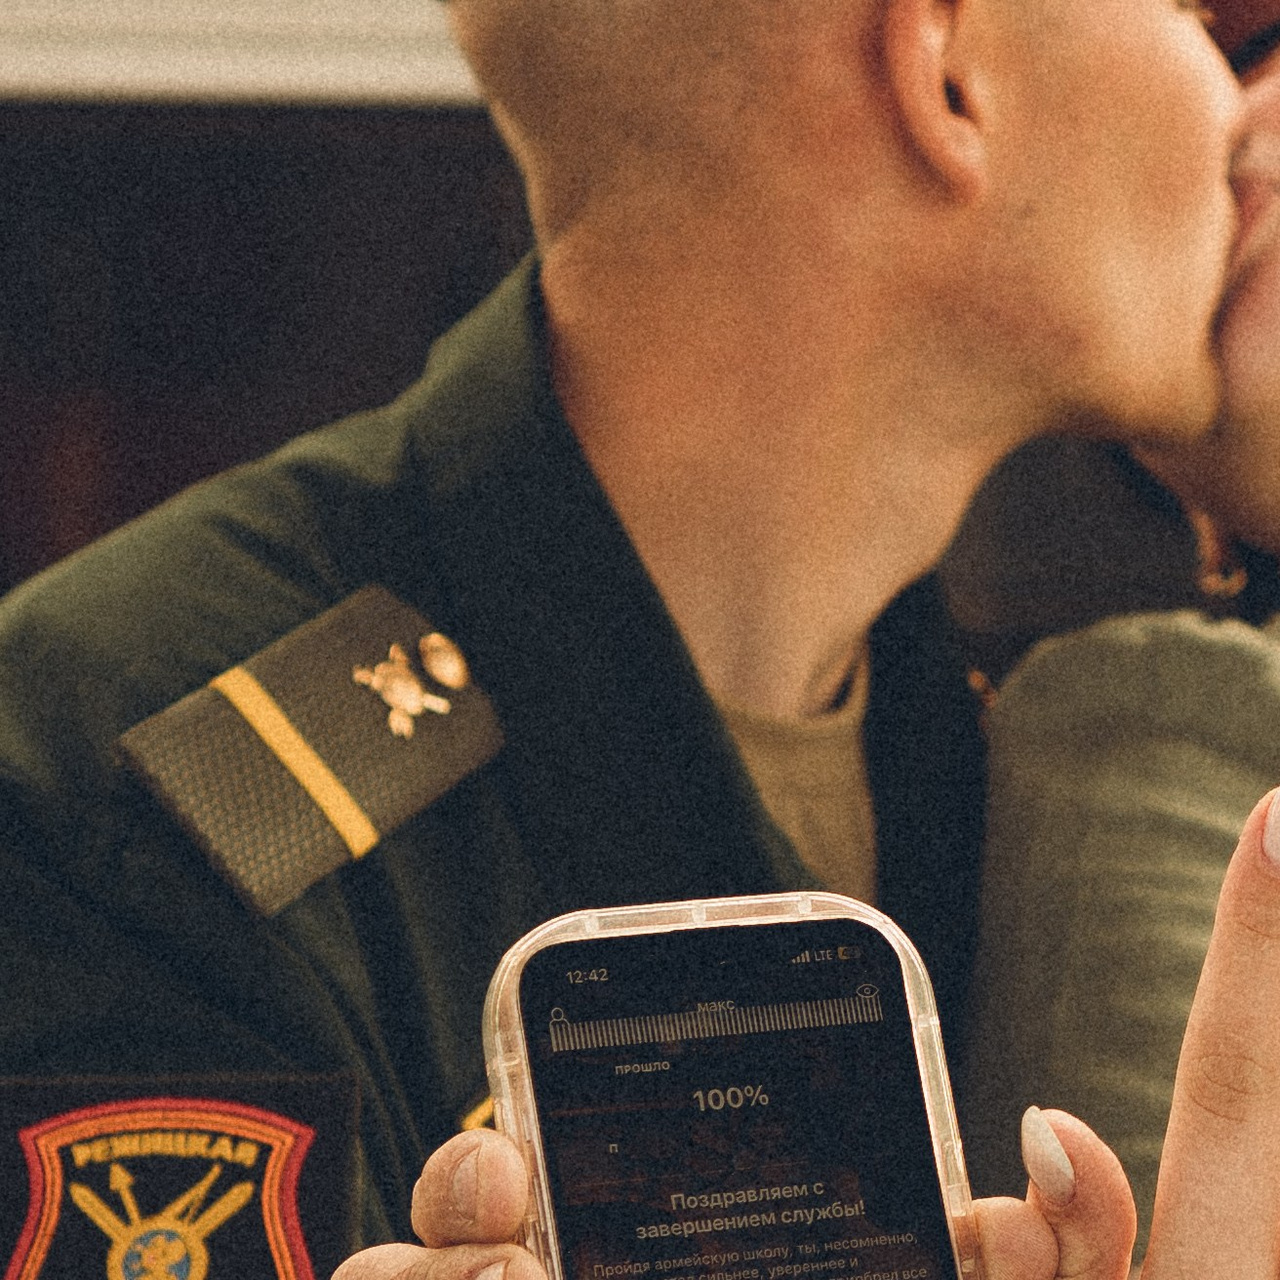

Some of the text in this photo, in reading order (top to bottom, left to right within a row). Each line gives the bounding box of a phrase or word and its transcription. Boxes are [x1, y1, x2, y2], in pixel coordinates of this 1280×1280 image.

[814, 948, 833, 962] LTE
[566, 968, 609, 985] 12:42
[615, 1060, 671, 1075] прошло
[693, 1085, 770, 1113] 100%
[671, 1181, 824, 1209] Поздравляем с
[636, 1212, 776, 1239] завершением
[594, 1260, 651, 1278] Пройдя
[655, 1251, 739, 1272] армейскую
[769, 1260, 846, 1279] увереннее
[850, 1258, 858, 1267] и
[903, 1269, 927, 1279] все
